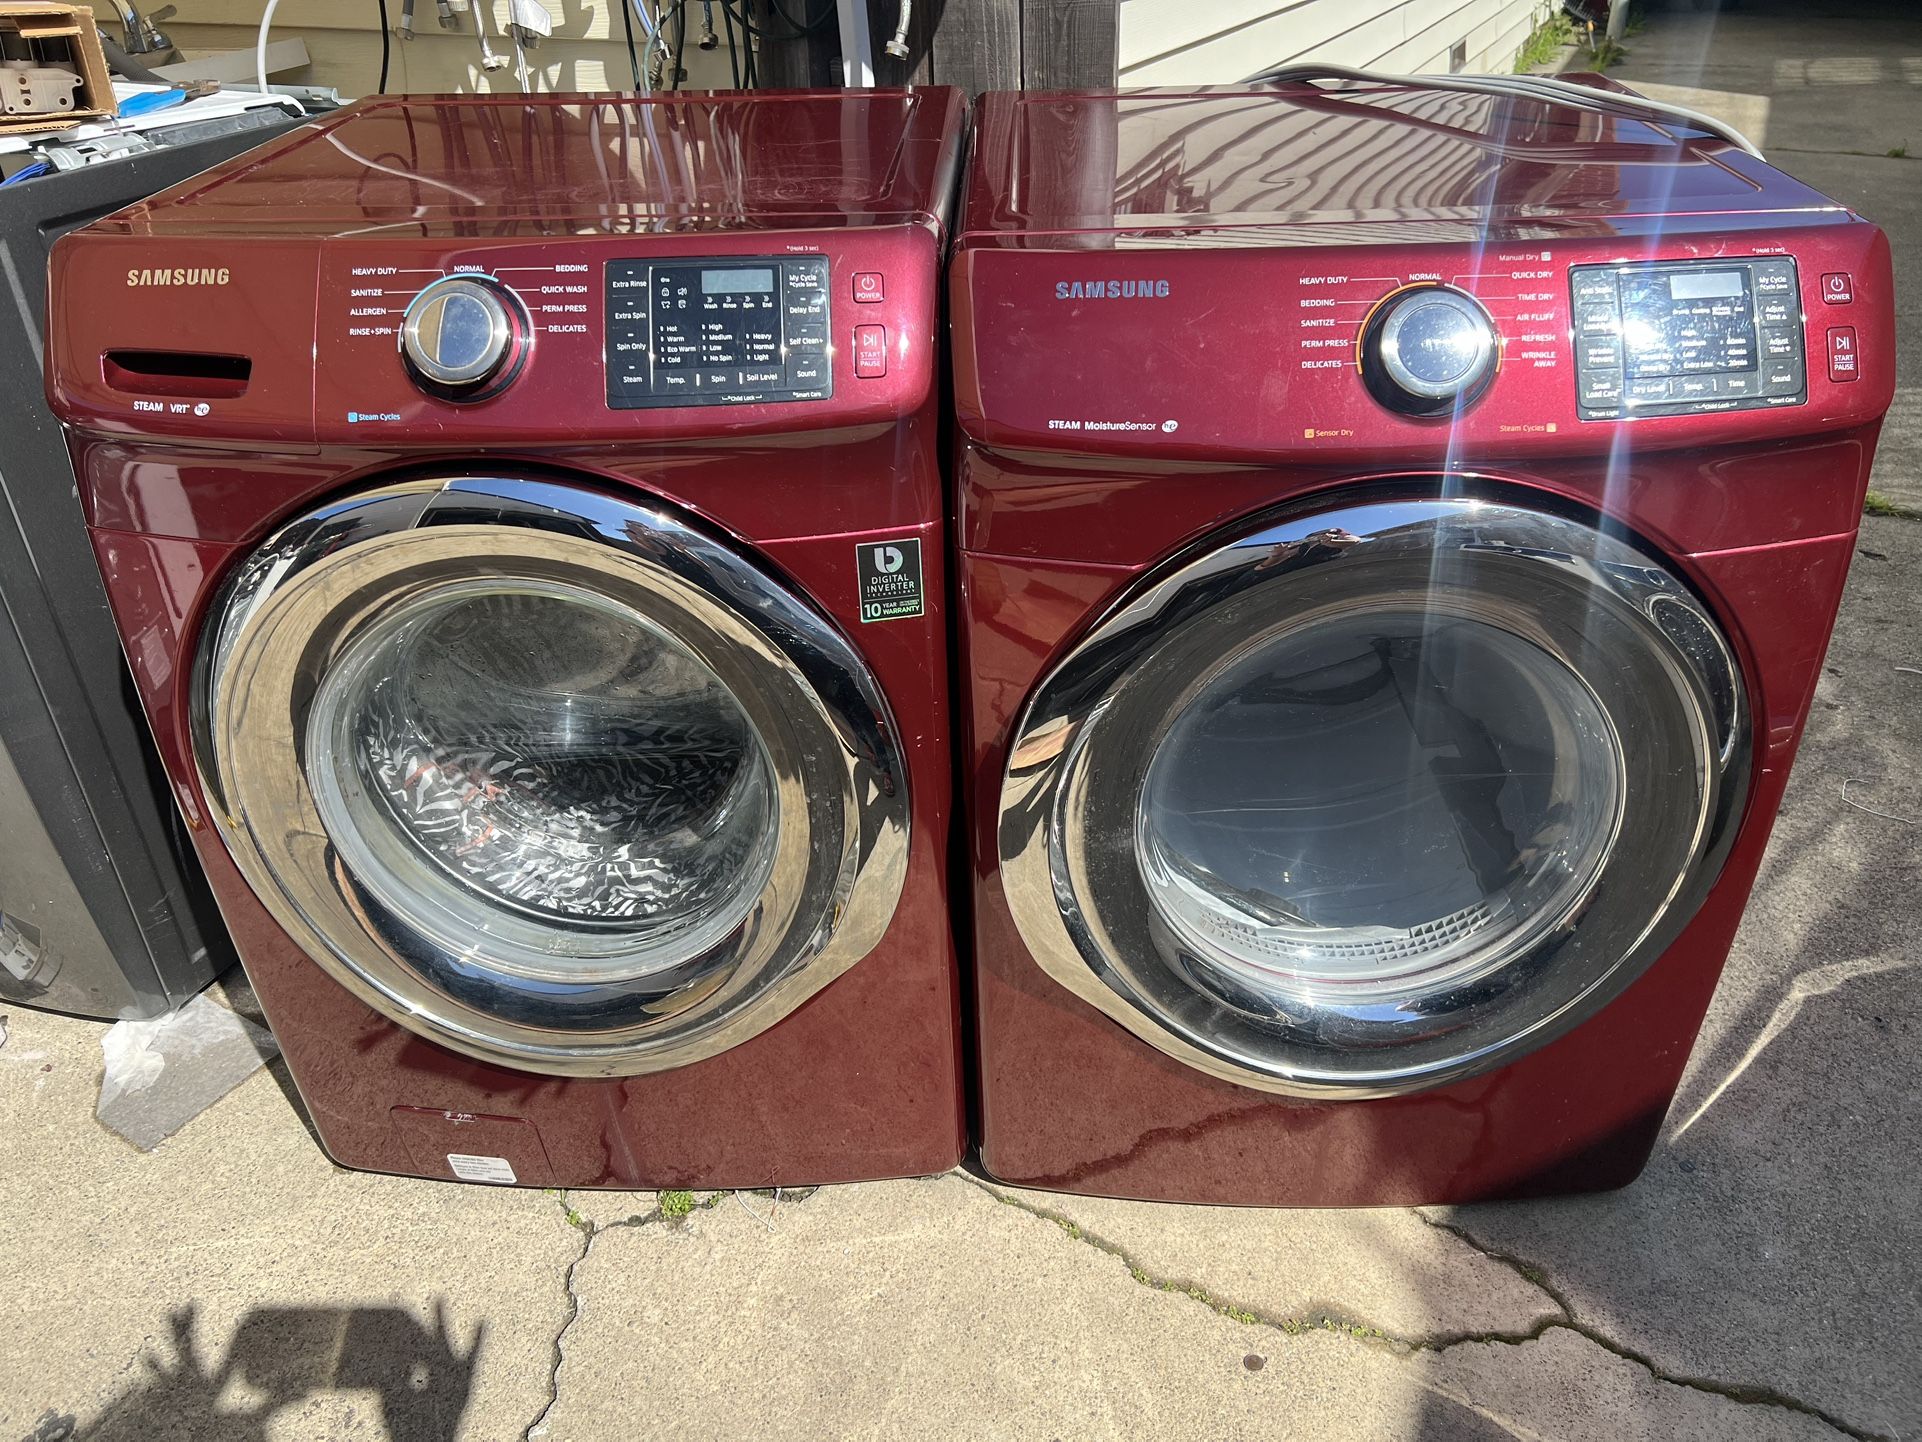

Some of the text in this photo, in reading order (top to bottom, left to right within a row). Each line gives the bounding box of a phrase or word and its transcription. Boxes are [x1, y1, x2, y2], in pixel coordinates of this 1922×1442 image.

[1525, 253, 1539, 262] Dry
[352, 267, 397, 276] HEAVY DUTY
[454, 265, 485, 273] NORMAL
[555, 264, 588, 272] BEDDING
[127, 268, 230, 286] SAMSUNG
[800, 274, 817, 282] Cycle
[1409, 273, 1442, 281] NORMAL
[1511, 271, 1553, 280] QUICK DRY
[1759, 275, 1787, 284] My Cycle
[630, 280, 647, 288] Rinse
[1299, 276, 1348, 285] HEAVY DUTY
[351, 288, 382, 296] SANITIZE
[541, 286, 564, 294] QUICK
[1055, 280, 1170, 299] SAMSUNG
[1517, 293, 1554, 301] TIME DRY
[1300, 299, 1335, 307] BEDDING
[350, 308, 387, 316] ALLERGEN
[790, 307, 807, 315] Delay
[1765, 305, 1785, 314] Adjust
[615, 312, 646, 320] Extra Spin
[1516, 313, 1555, 322] AIR FLUFF
[1301, 319, 1335, 327] SANITIZE
[349, 328, 392, 336] RINSE+SPIN
[709, 333, 732, 341] Medium
[753, 333, 772, 341] Heavy
[1521, 334, 1556, 342] REFRESH
[1301, 339, 1349, 348] PERM PRESS
[1770, 337, 1789, 346] Adjust
[616, 343, 646, 351] Spin Only
[719, 354, 733, 362] Spin
[753, 354, 769, 362] Light
[1521, 351, 1556, 359] WRINKLE
[1301, 360, 1342, 369] DELICATES
[1533, 360, 1556, 368] AWAY
[1834, 363, 1854, 371] PAUSE
[746, 373, 778, 381] Soil Level
[797, 370, 817, 378] Sound
[666, 376, 686, 384] Temp.
[711, 375, 726, 383] Spin
[1771, 374, 1791, 383] Sound
[1592, 382, 1611, 391] Small
[1728, 380, 1746, 388] Time
[1586, 390, 1602, 399] Load
[134, 401, 164, 412] STEAM
[358, 413, 400, 422] Steam Cycles
[1048, 420, 1080, 430] STEAM
[1085, 421, 1157, 431] MoistureSensor
[1500, 424, 1545, 433] Steam Cycles
[1315, 429, 1354, 438] Sensor Dry
[871, 574, 909, 585] DIGITAL
[867, 581, 915, 593] INVERTER
[864, 603, 882, 618] 10
[882, 605, 920, 615] WARRANTY
